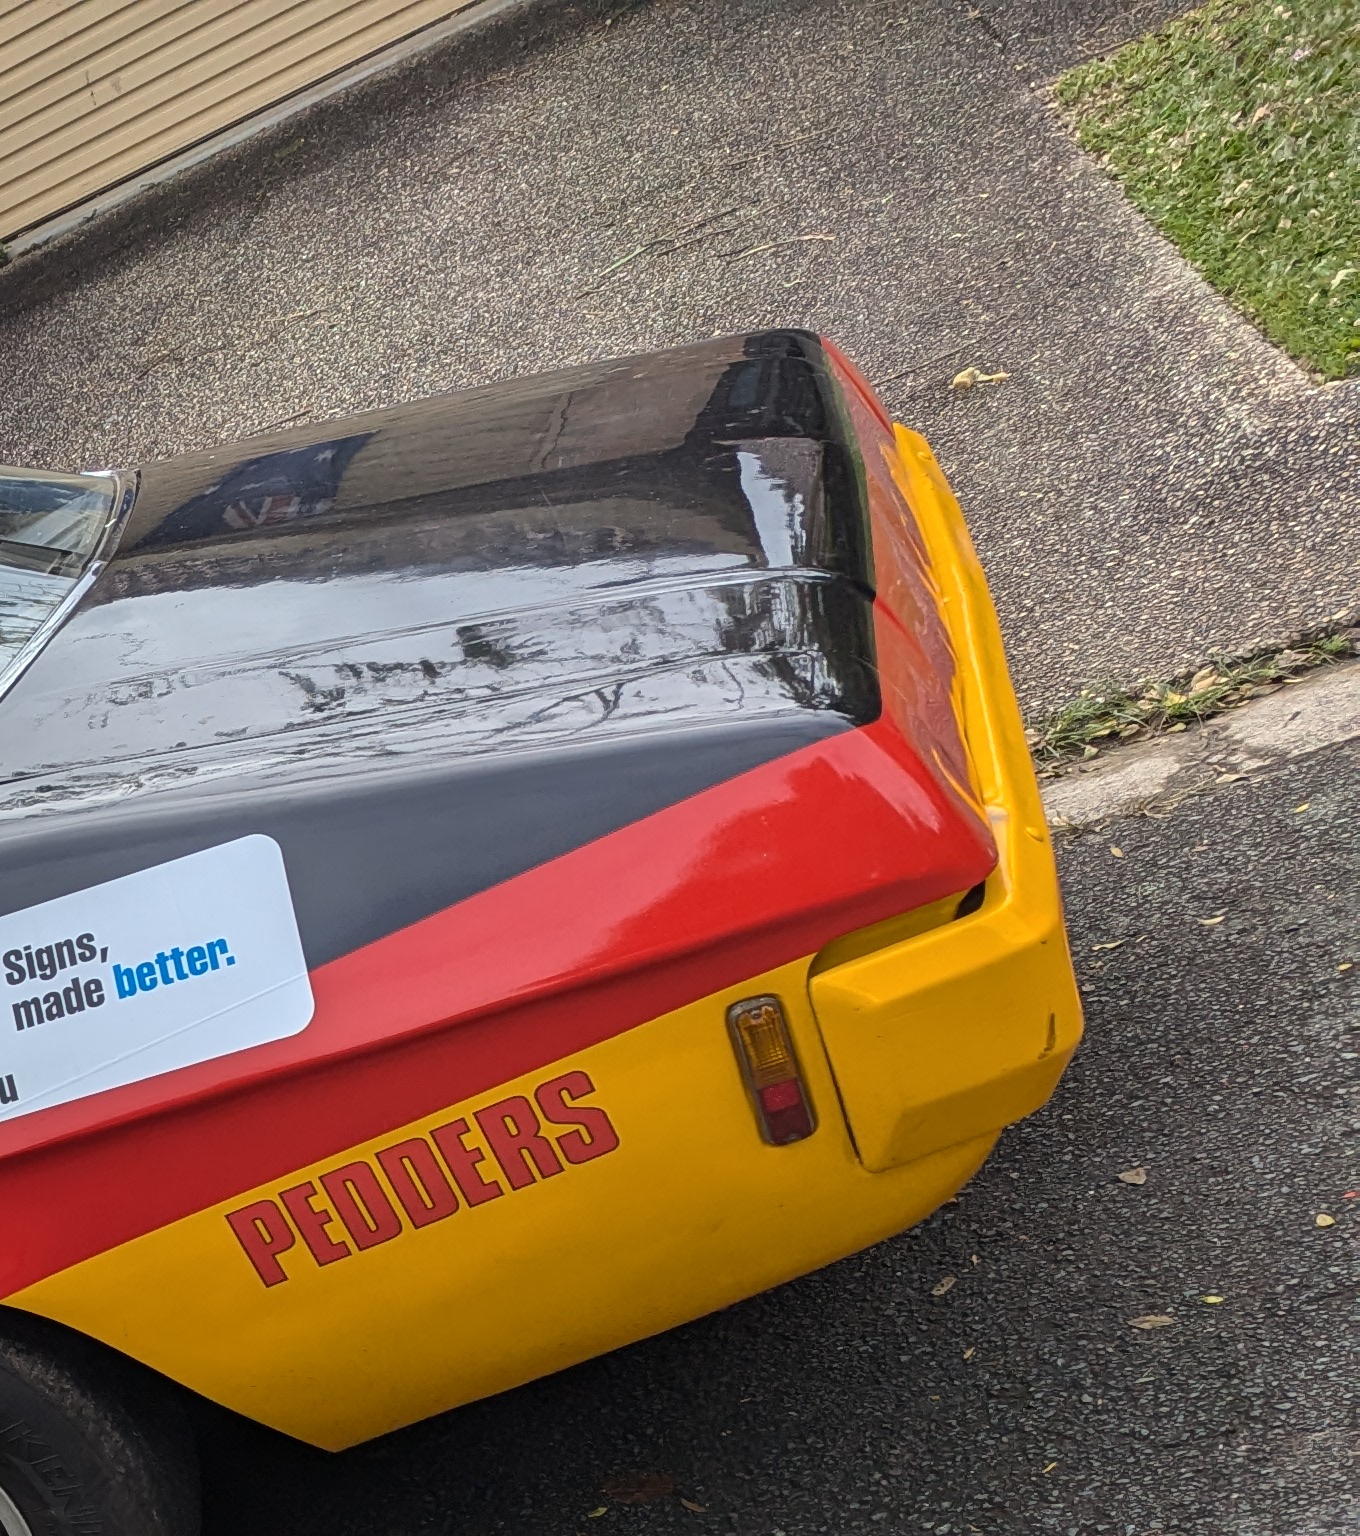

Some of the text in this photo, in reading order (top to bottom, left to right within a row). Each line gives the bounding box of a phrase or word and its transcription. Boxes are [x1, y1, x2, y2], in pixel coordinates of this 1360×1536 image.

[3, 929, 110, 985] Signs,
[12, 935, 236, 1032] made better.
[224, 1070, 620, 1288] PEDDERS
